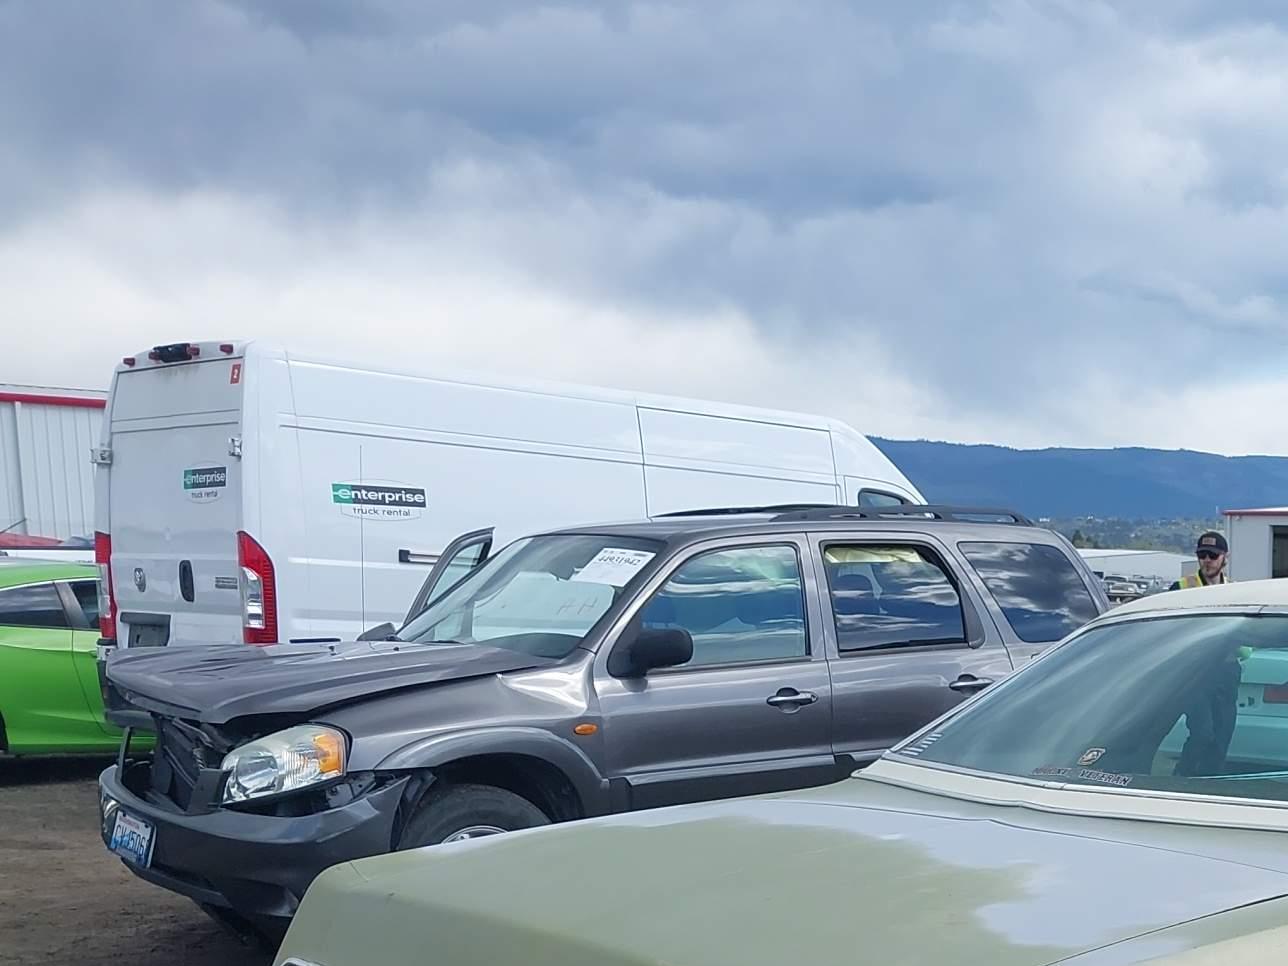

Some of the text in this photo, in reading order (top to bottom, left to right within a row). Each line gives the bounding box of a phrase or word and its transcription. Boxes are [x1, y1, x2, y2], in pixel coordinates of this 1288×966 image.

[184, 470, 226, 486] enterprise
[332, 488, 425, 504] enterprise
[353, 507, 411, 517] truck rental
